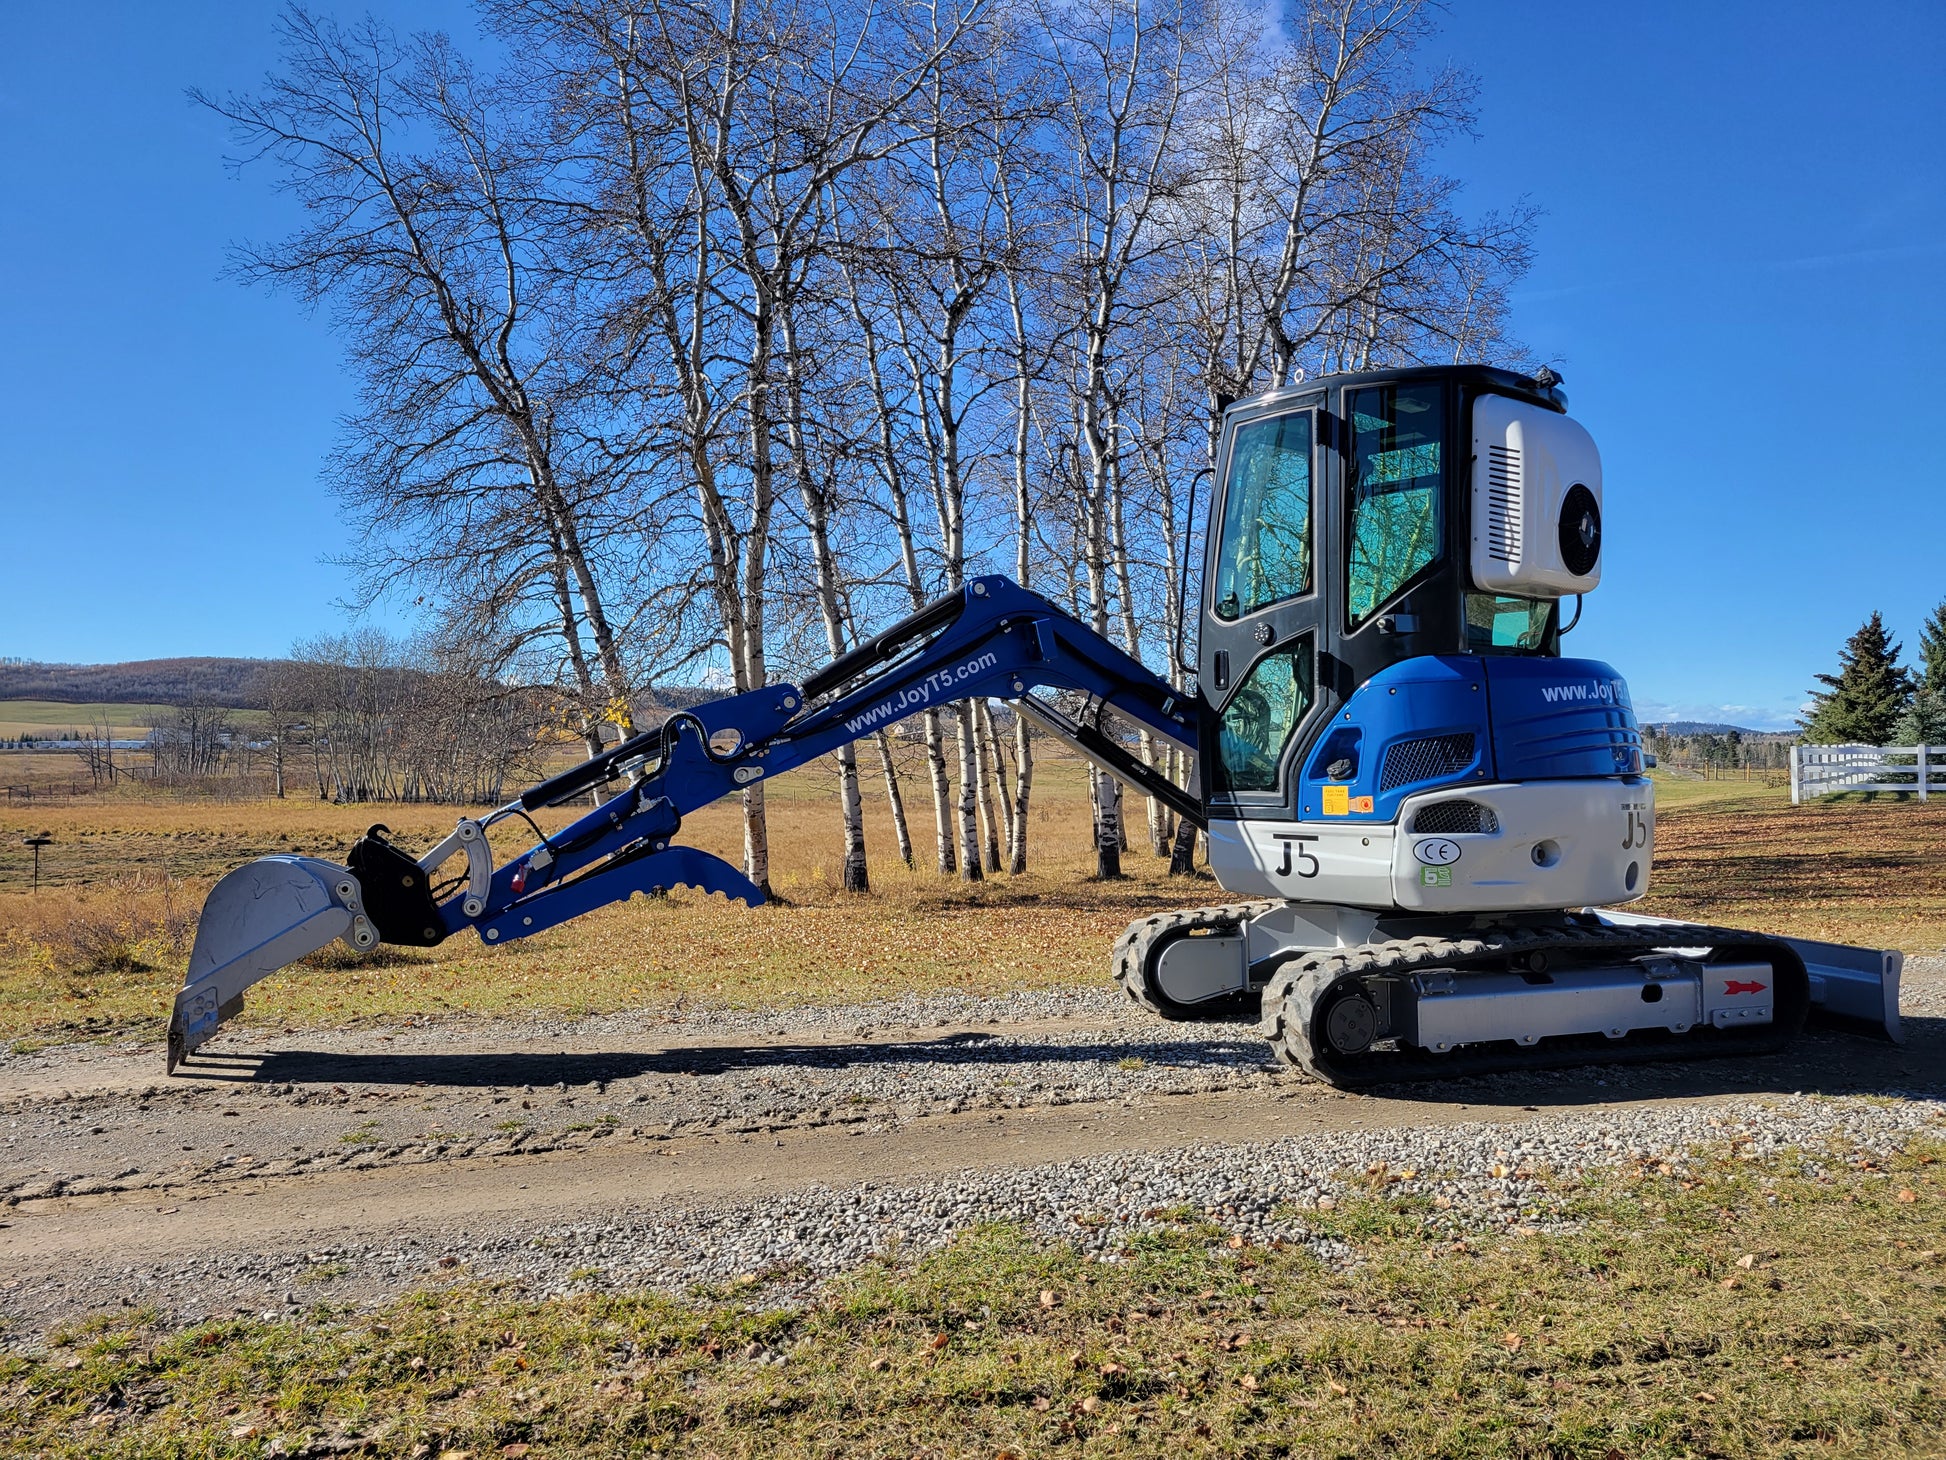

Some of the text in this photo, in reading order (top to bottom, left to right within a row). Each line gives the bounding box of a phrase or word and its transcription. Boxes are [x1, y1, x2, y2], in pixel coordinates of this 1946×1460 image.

[845, 652, 997, 734] www.JoyT5.com
[1273, 833, 1320, 879] J5
[1424, 843, 1448, 860] CE
